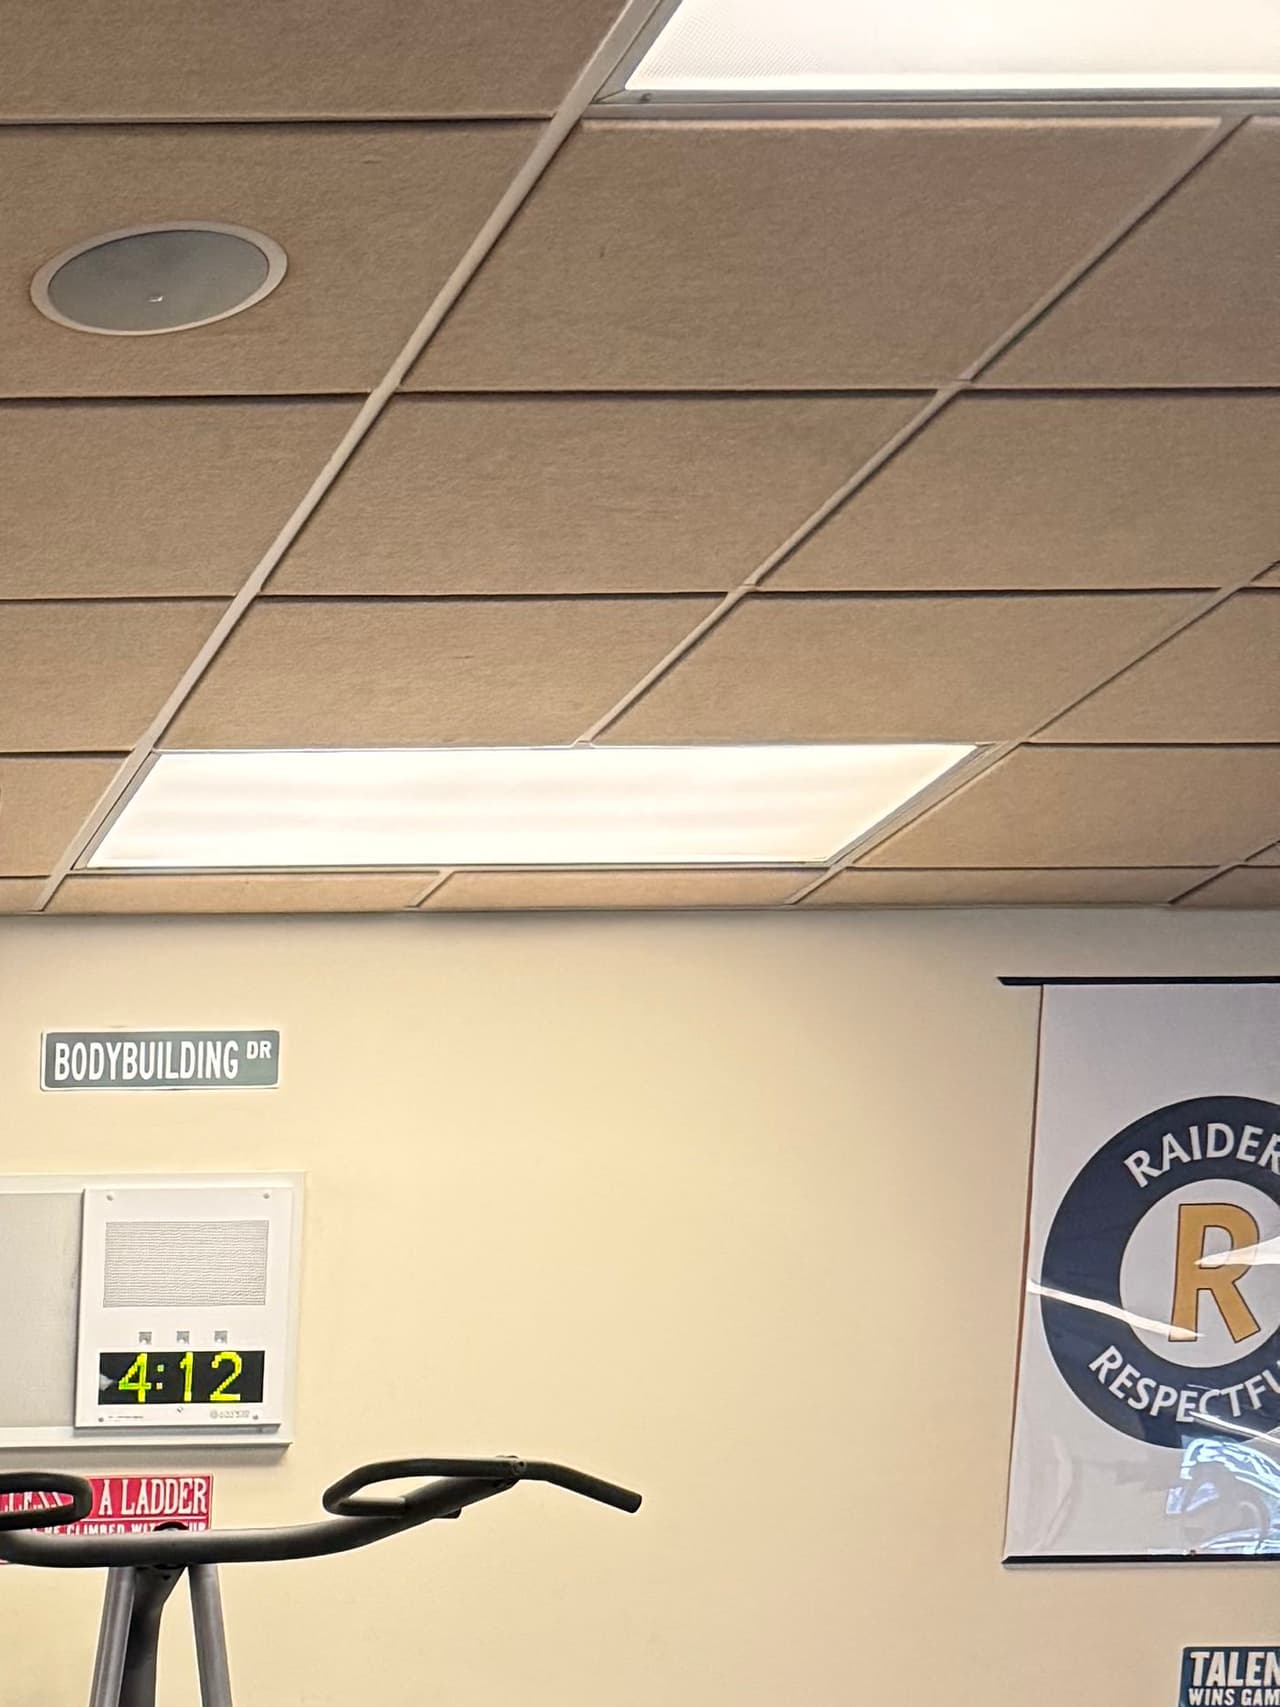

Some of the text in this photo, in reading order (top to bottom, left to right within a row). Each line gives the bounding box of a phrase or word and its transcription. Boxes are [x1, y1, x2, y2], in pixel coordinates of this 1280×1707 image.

[54, 1040, 272, 1081] BODYBUILDING DR
[1168, 1202, 1261, 1344] R
[118, 1351, 242, 1402] 4:12
[98, 1479, 113, 1515] A
[121, 1477, 207, 1515] LADDER
[1188, 1688, 1236, 1706] WINS
